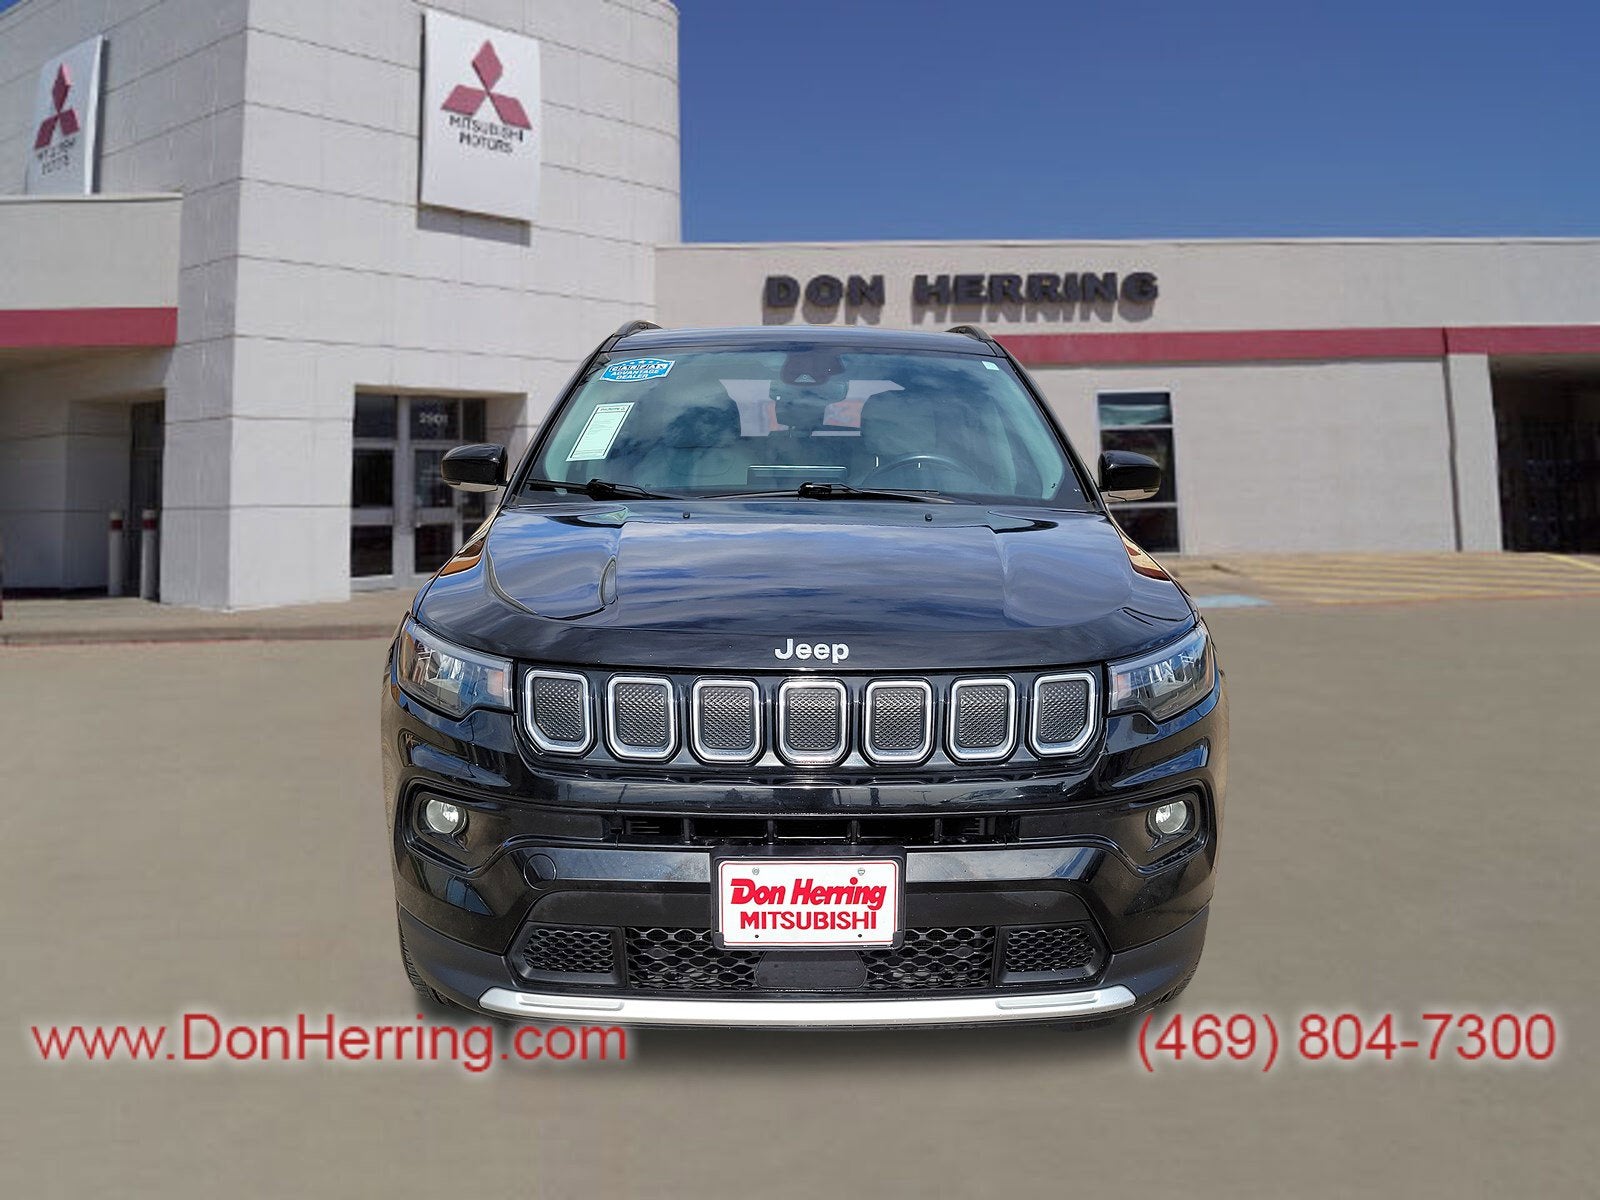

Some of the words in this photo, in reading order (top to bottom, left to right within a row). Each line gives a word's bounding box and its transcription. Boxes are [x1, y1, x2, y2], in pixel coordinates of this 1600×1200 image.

[459, 132, 513, 154] MOTORS
[764, 274, 885, 306] DON
[912, 271, 1159, 306] HERRING
[774, 638, 850, 664] Jeep
[730, 878, 786, 906] Don
[790, 876, 887, 911] Herring
[740, 911, 877, 930] MITSUBISHI
